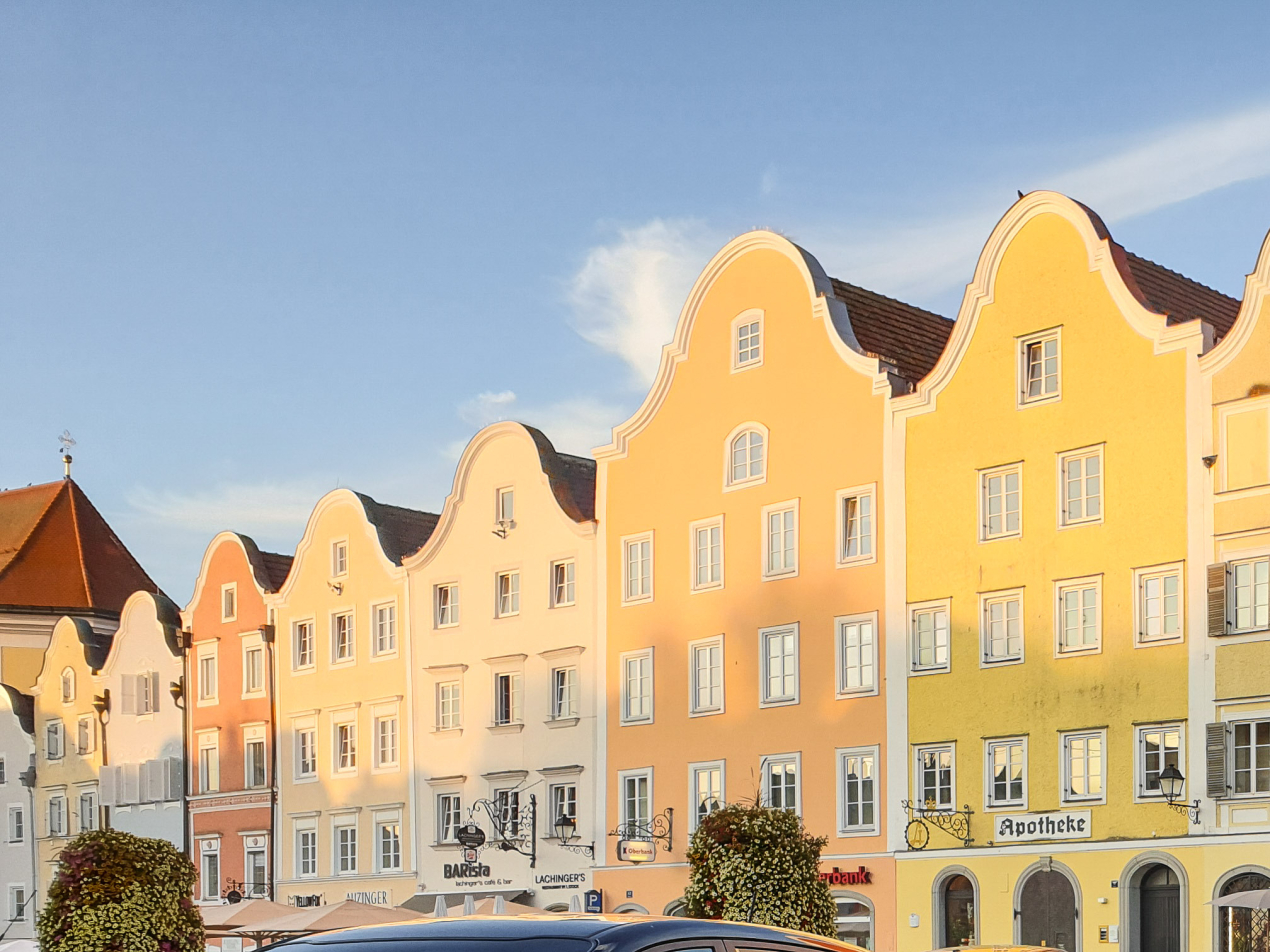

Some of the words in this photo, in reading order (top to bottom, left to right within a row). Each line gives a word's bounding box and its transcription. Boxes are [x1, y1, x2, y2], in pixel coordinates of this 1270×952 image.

[999, 816, 1087, 838] Apotheke
[443, 862, 492, 879] BARista
[535, 872, 586, 884] LACHINGER'S
[589, 894, 598, 906] P
